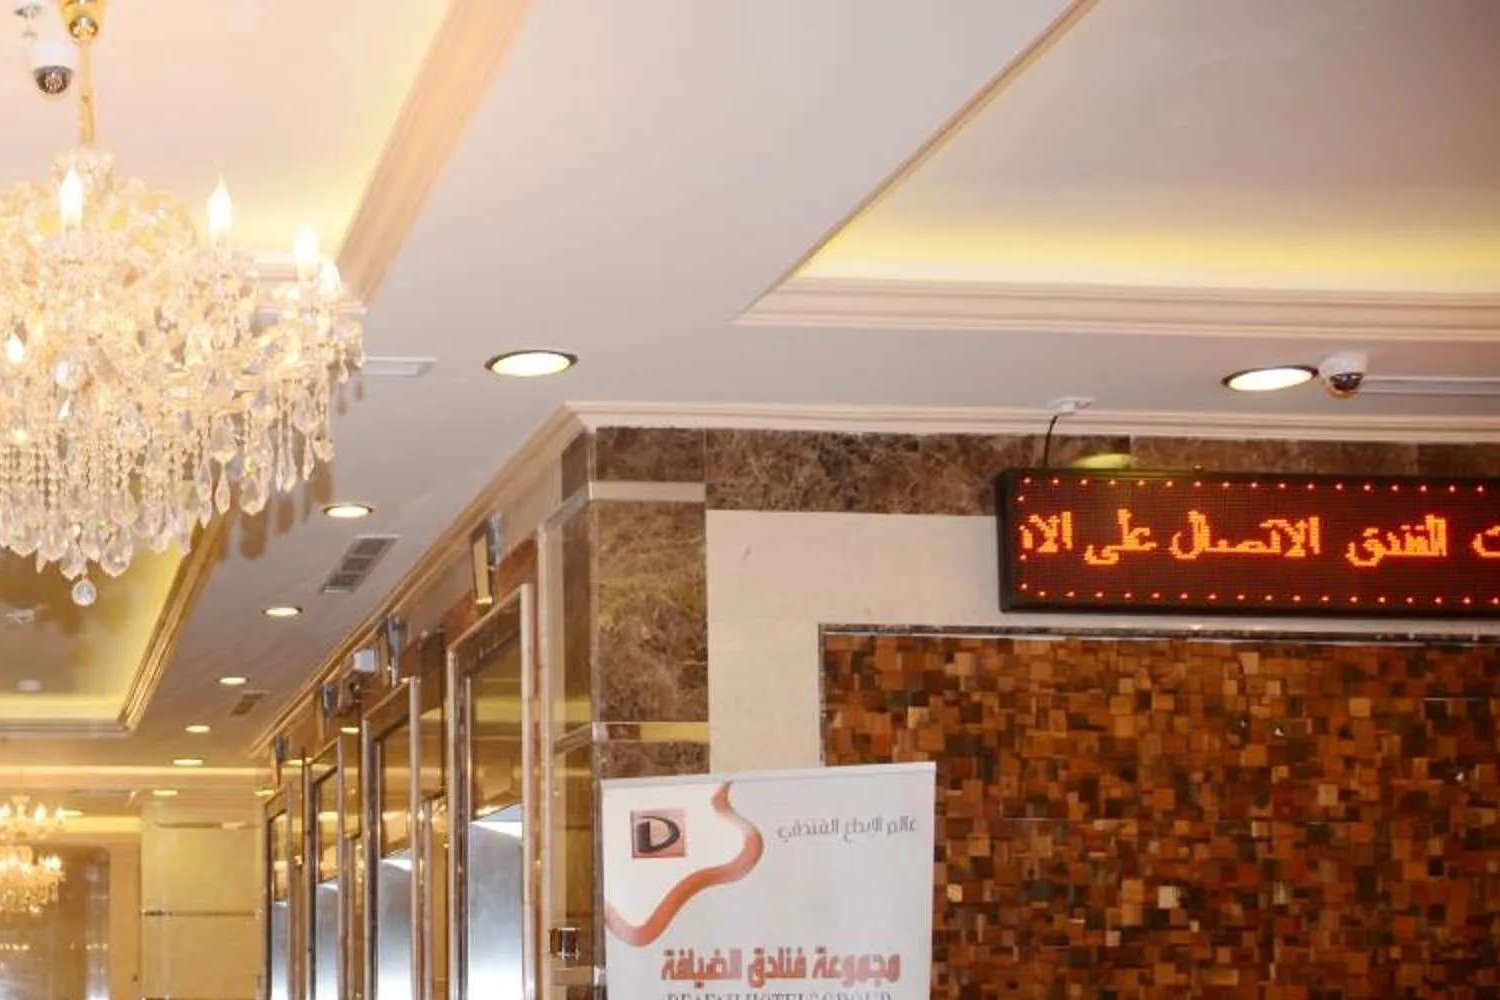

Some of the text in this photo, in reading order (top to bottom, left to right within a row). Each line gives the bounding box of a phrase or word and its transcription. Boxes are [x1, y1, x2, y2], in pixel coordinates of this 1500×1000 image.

[660, 947, 901, 989] مجموعة فنادق الضيافة
